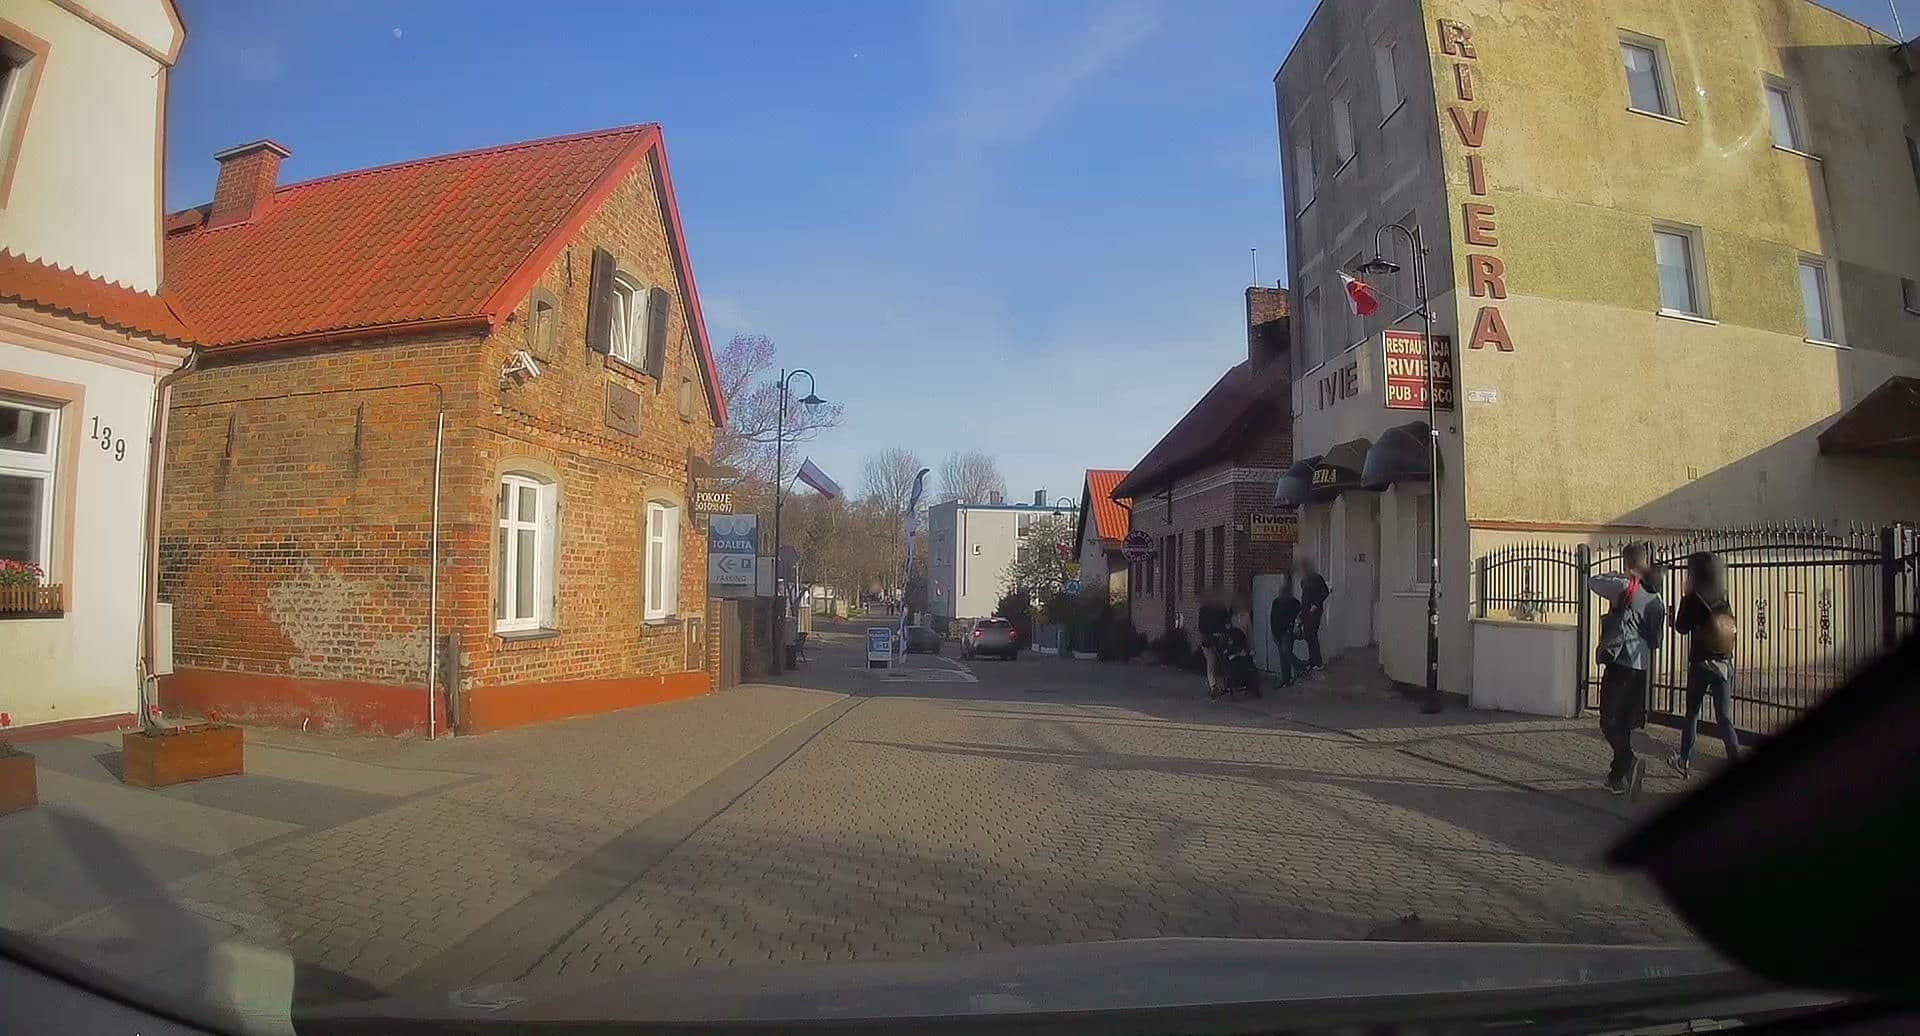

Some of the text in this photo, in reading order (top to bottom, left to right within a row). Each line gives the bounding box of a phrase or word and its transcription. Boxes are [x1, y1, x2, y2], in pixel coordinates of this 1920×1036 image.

[1436, 18, 1514, 352] RIVIERA
[1386, 338, 1450, 357] RESTAURCJA
[1387, 357, 1452, 378] RIVIERA
[1389, 385, 1411, 401] PUB
[1420, 386, 1452, 403] DSCO
[91, 416, 125, 461] 139
[697, 493, 732, 503] POKOJE
[1252, 513, 1297, 524] Riviera
[712, 540, 753, 550] TOALETA
